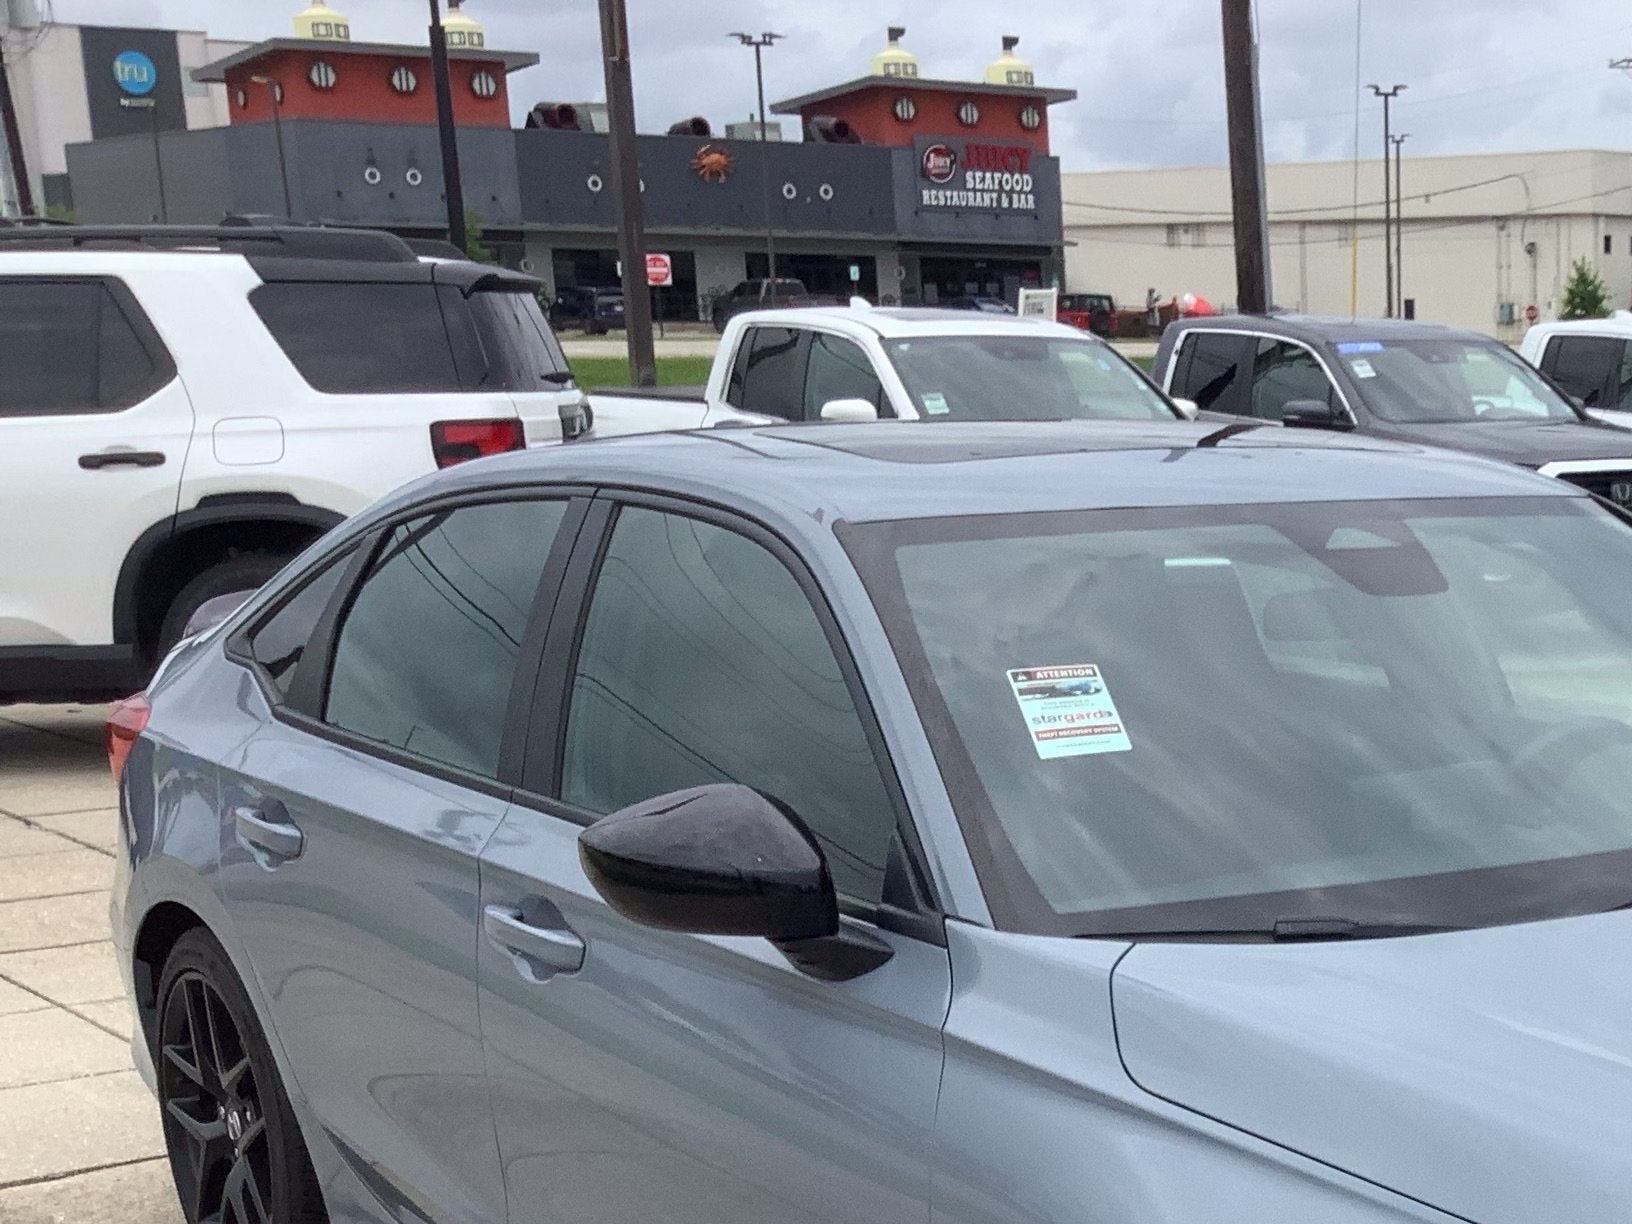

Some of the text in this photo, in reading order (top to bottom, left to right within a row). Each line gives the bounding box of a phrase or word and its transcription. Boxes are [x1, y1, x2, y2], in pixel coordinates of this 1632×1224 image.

[113, 60, 147, 82] tru
[965, 171, 1032, 192] SEAFOOD
[922, 189, 1035, 209] RESTAURANT & BAR
[1036, 668, 1093, 679] ATTENTION
